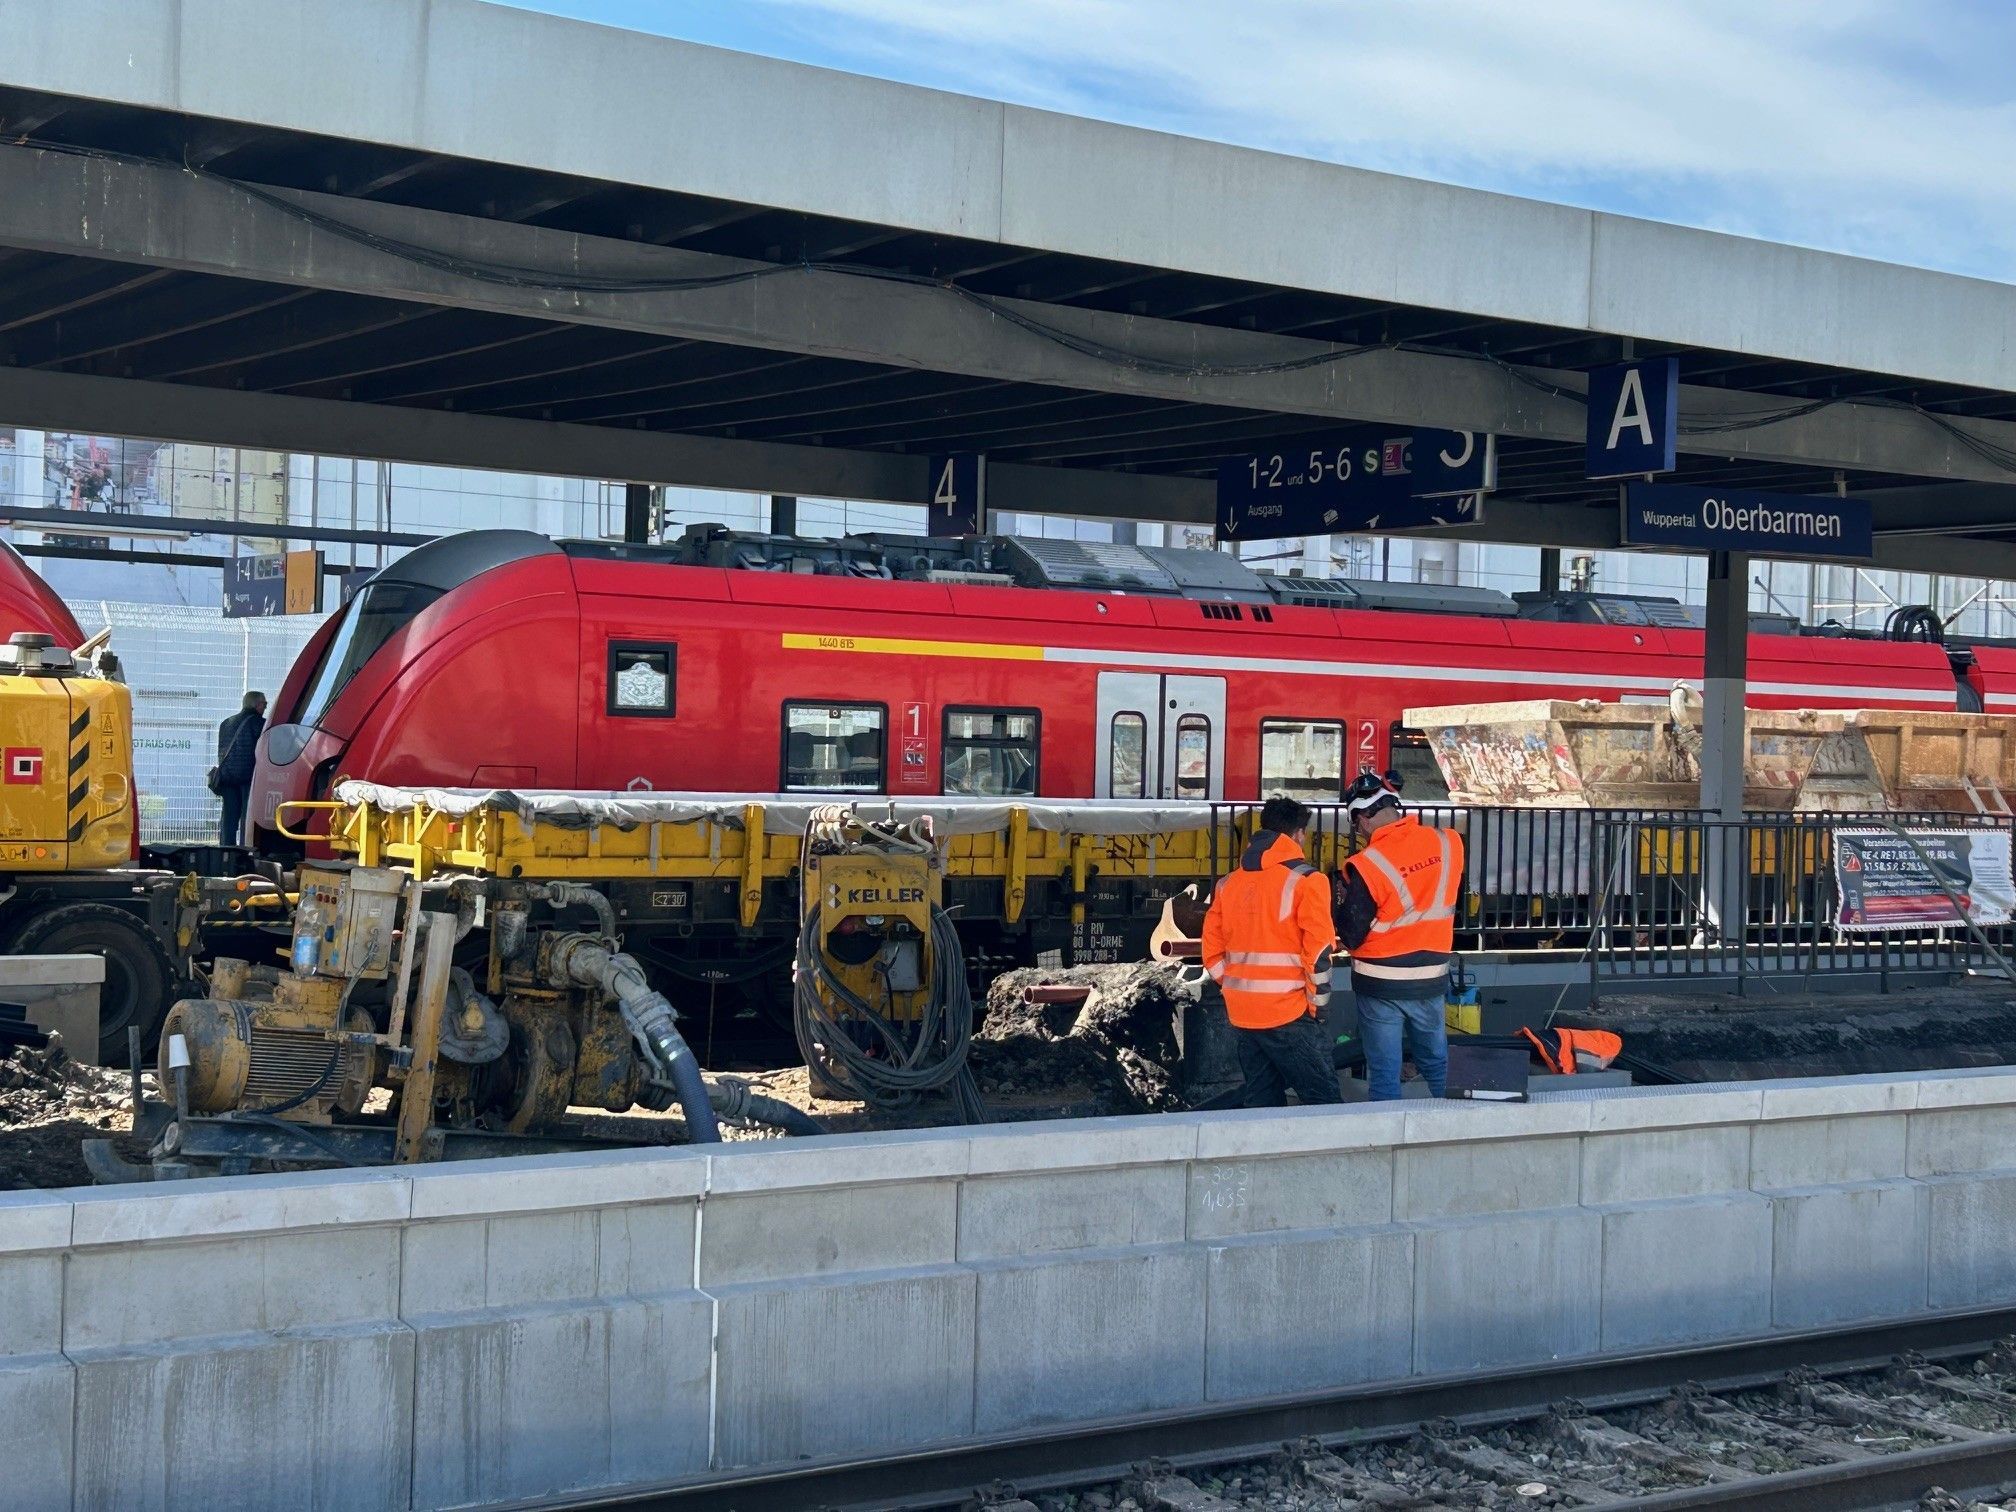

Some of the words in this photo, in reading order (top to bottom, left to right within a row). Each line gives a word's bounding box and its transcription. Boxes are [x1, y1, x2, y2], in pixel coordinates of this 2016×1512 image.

[1606, 369, 1653, 450] A
[1249, 455, 1283, 489] 1-2
[1287, 473, 1303, 486] und
[1309, 447, 1351, 484] 5-6
[934, 458, 957, 516] 4
[1248, 504, 1283, 517] Ausgang
[1643, 510, 1696, 528] Wuppertal
[1703, 498, 1841, 538] Oberbarmen
[908, 705, 920, 736] 1
[1360, 722, 1374, 750] 2
[848, 887, 924, 904] KELLER
[1090, 922, 1104, 935] RIV
